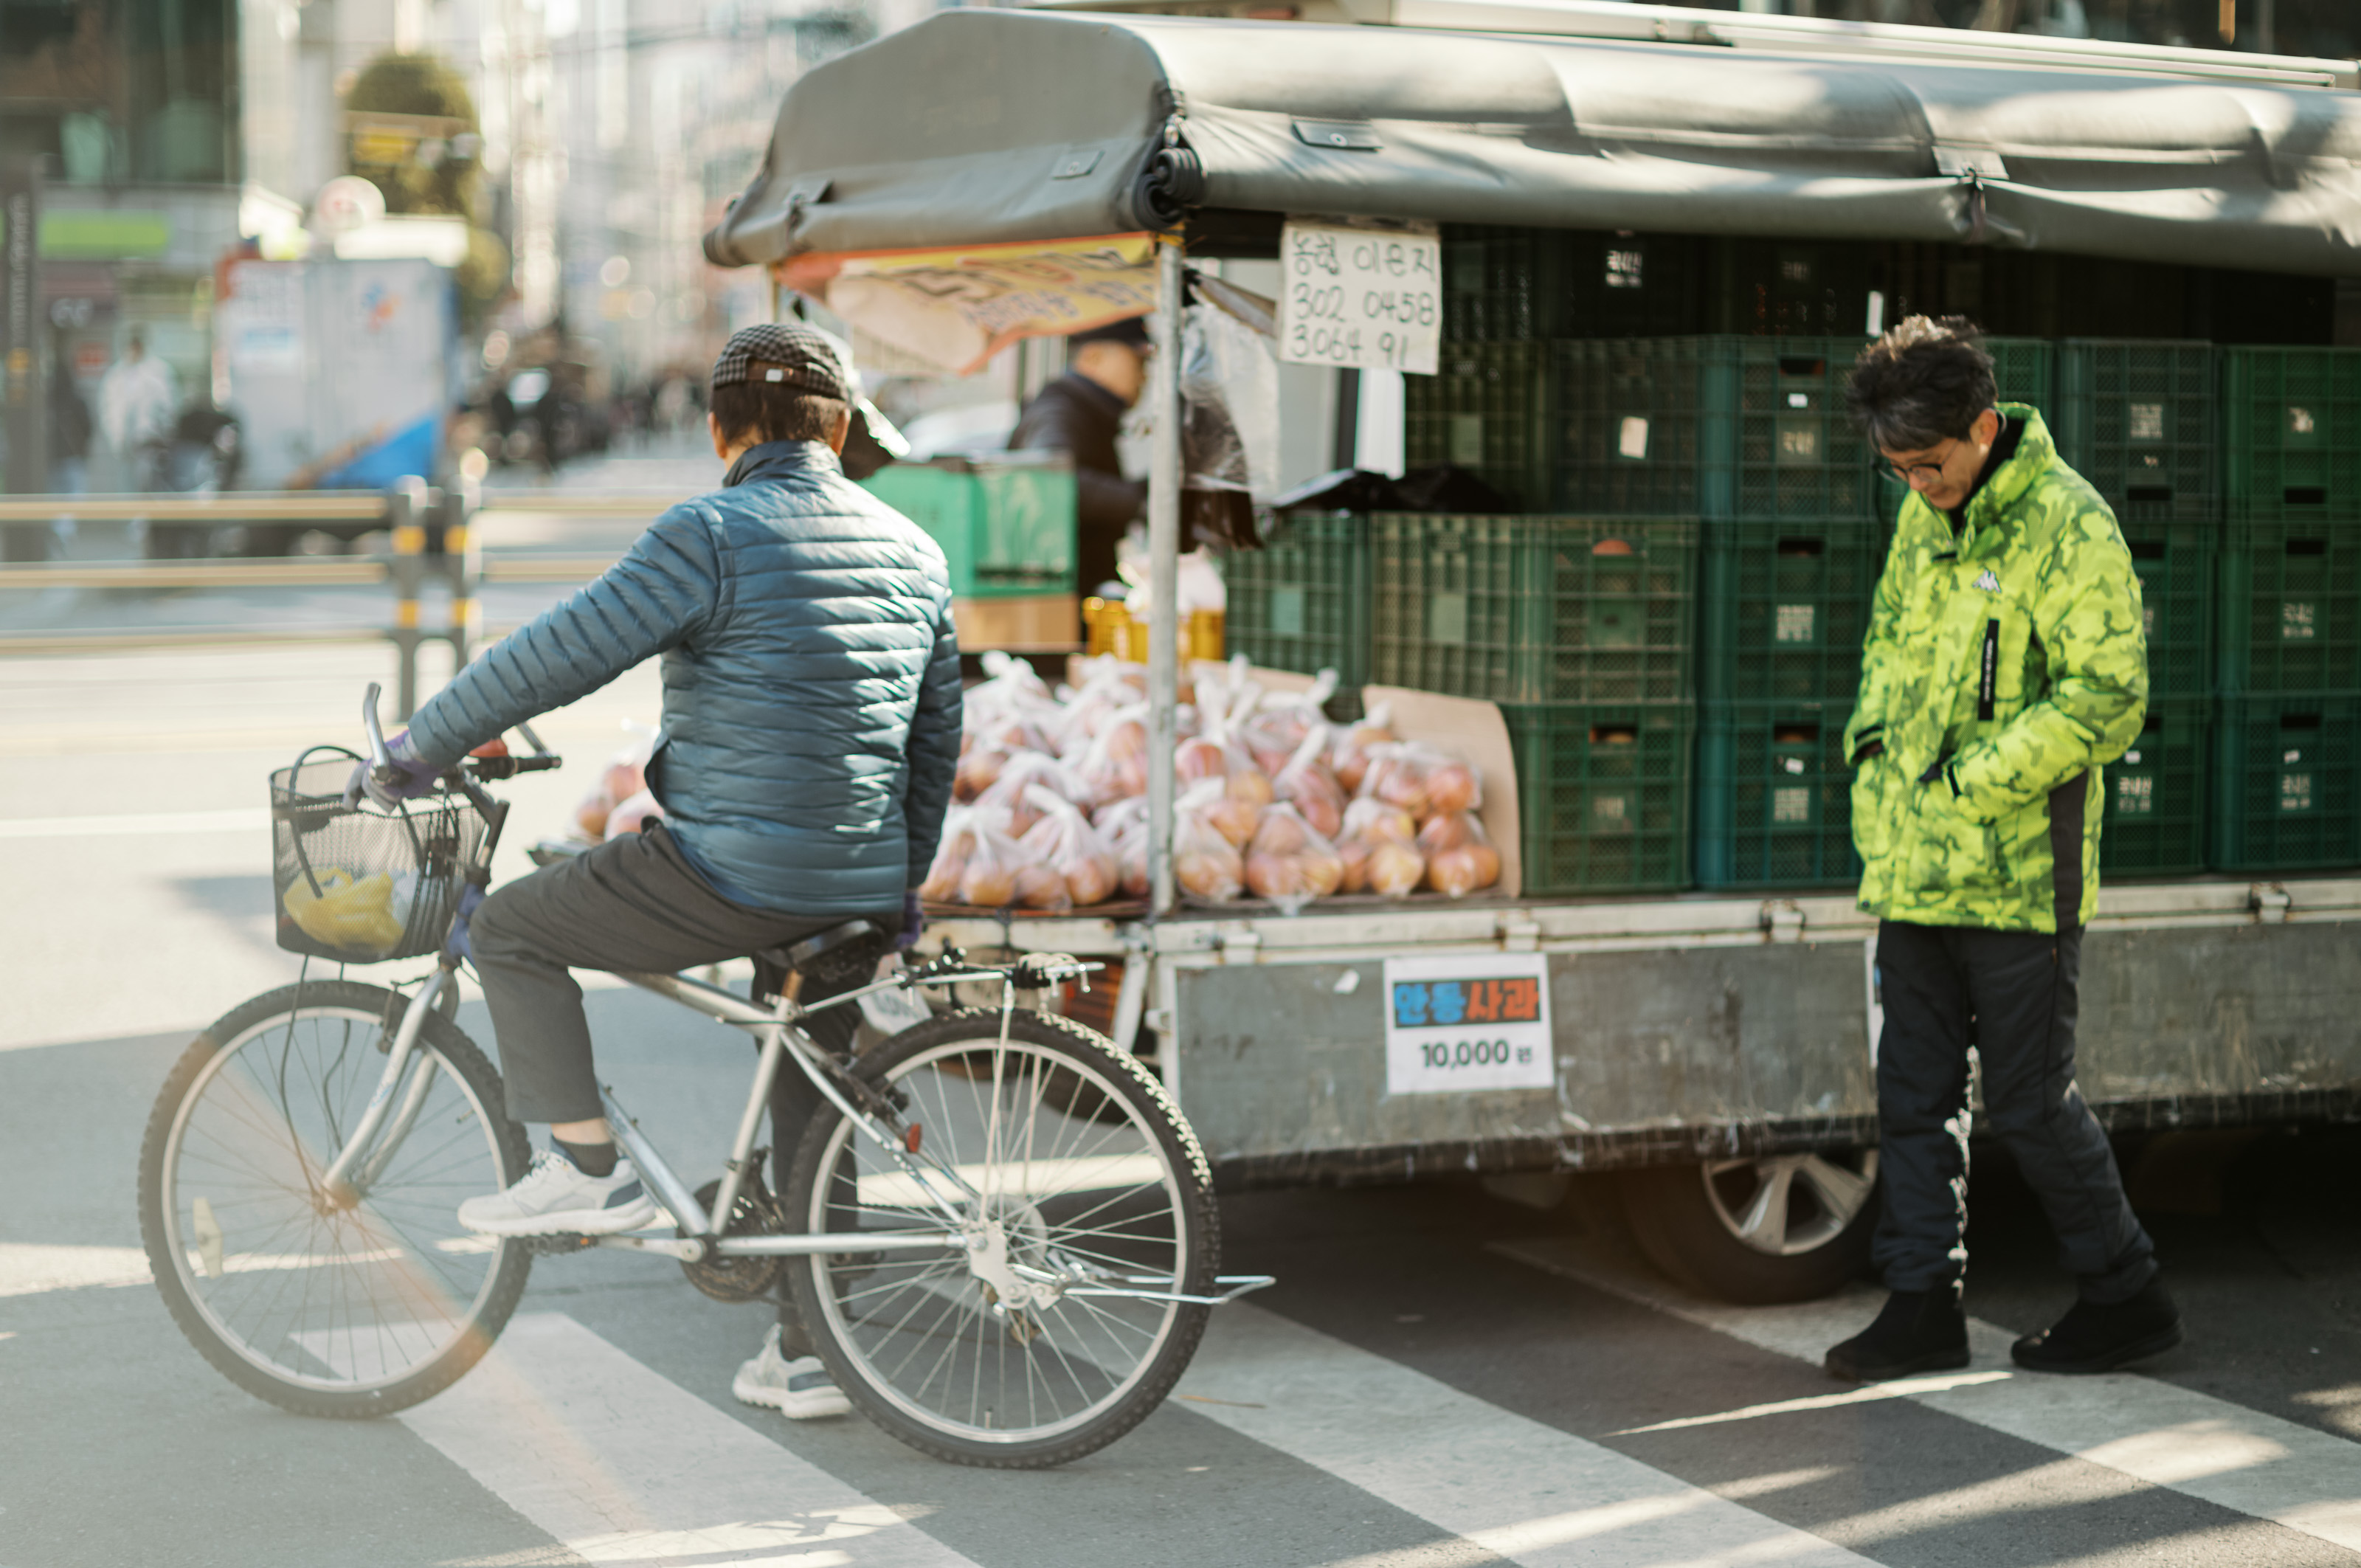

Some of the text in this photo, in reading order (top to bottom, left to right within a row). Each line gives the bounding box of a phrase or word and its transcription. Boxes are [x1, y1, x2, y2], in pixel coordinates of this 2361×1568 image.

[1293, 283, 1435, 326] 302 0458
[1292, 324, 1408, 367] 3064 91
